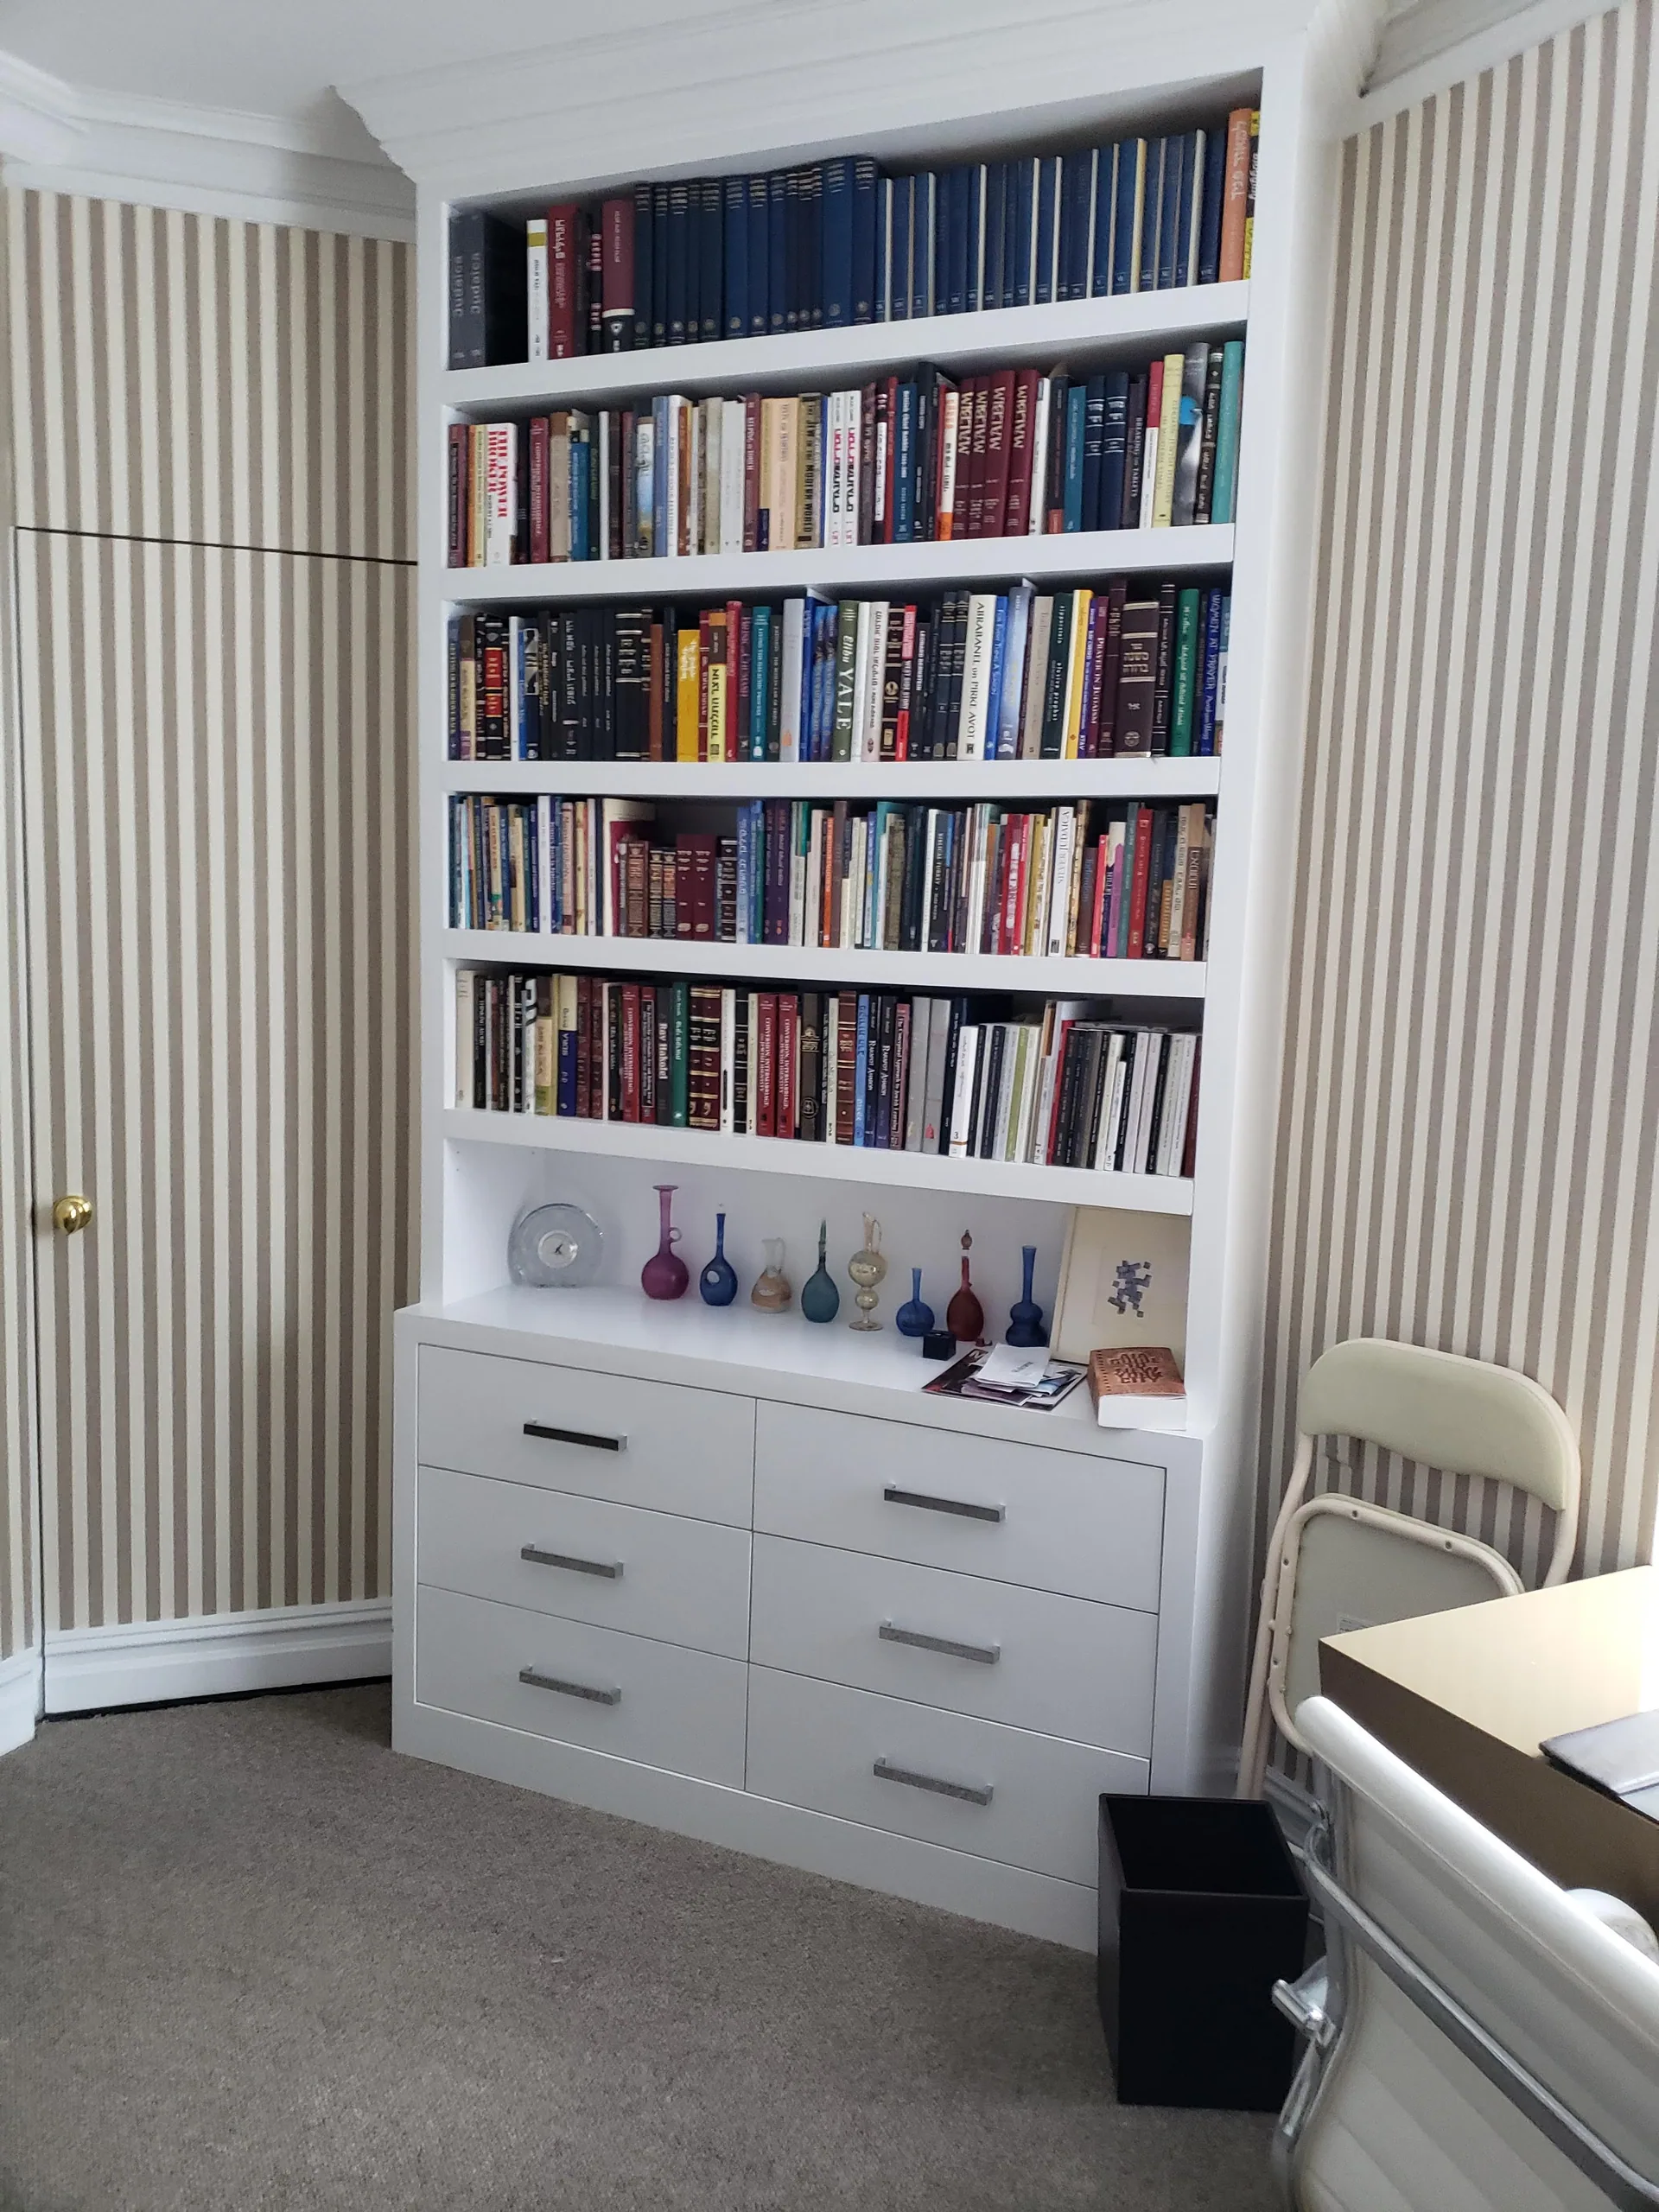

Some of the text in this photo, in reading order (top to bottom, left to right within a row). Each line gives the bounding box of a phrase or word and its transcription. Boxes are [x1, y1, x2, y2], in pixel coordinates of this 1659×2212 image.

[469, 251, 482, 315] Judaica
[804, 418, 816, 437] JEW
[497, 430, 508, 518] THE POWER
[803, 464, 814, 501] MODERN
[802, 502, 814, 533] WORLD
[1208, 594, 1222, 633] WOMEN
[970, 601, 986, 665] ABRABANEL
[915, 629, 927, 691] LEONARD BERNSTEIN
[1095, 637, 1106, 672] PRAYER
[1205, 653, 1218, 691] PRAYER
[836, 667, 855, 731] YALE
[968, 680, 980, 709] PIRKE
[1090, 686, 1103, 725] JUDAISM
[965, 711, 977, 741] AVOT
[658, 1022, 669, 1041] Rav
